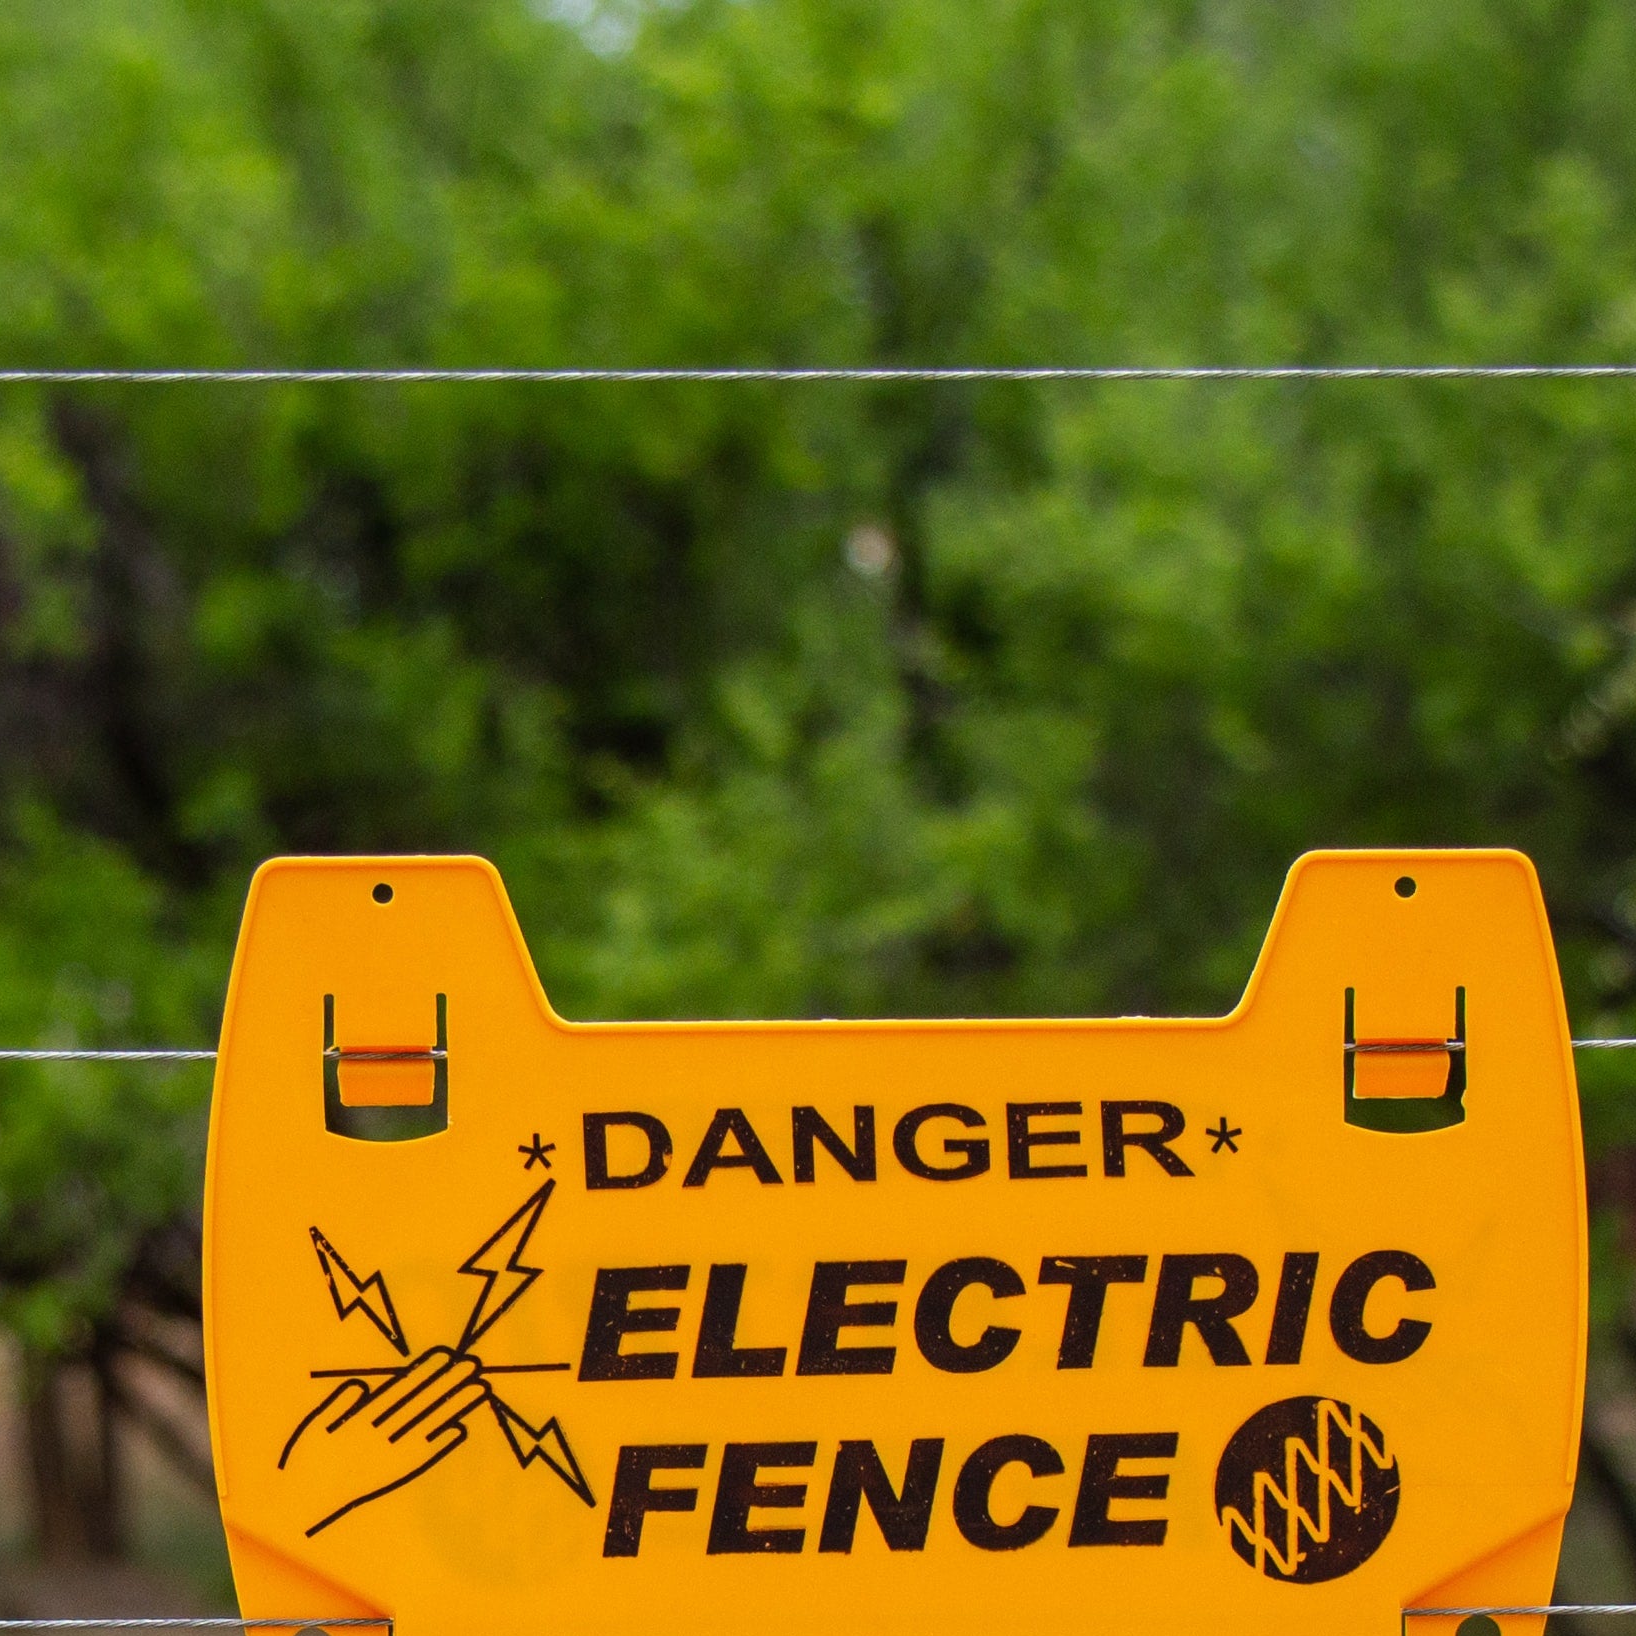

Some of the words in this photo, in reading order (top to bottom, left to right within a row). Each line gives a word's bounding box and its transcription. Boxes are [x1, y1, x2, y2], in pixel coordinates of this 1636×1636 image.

[583, 1100, 1196, 1190] DANGER
[578, 1249, 1437, 1383] ELECTRIC
[602, 1431, 1180, 1558] FENCE
